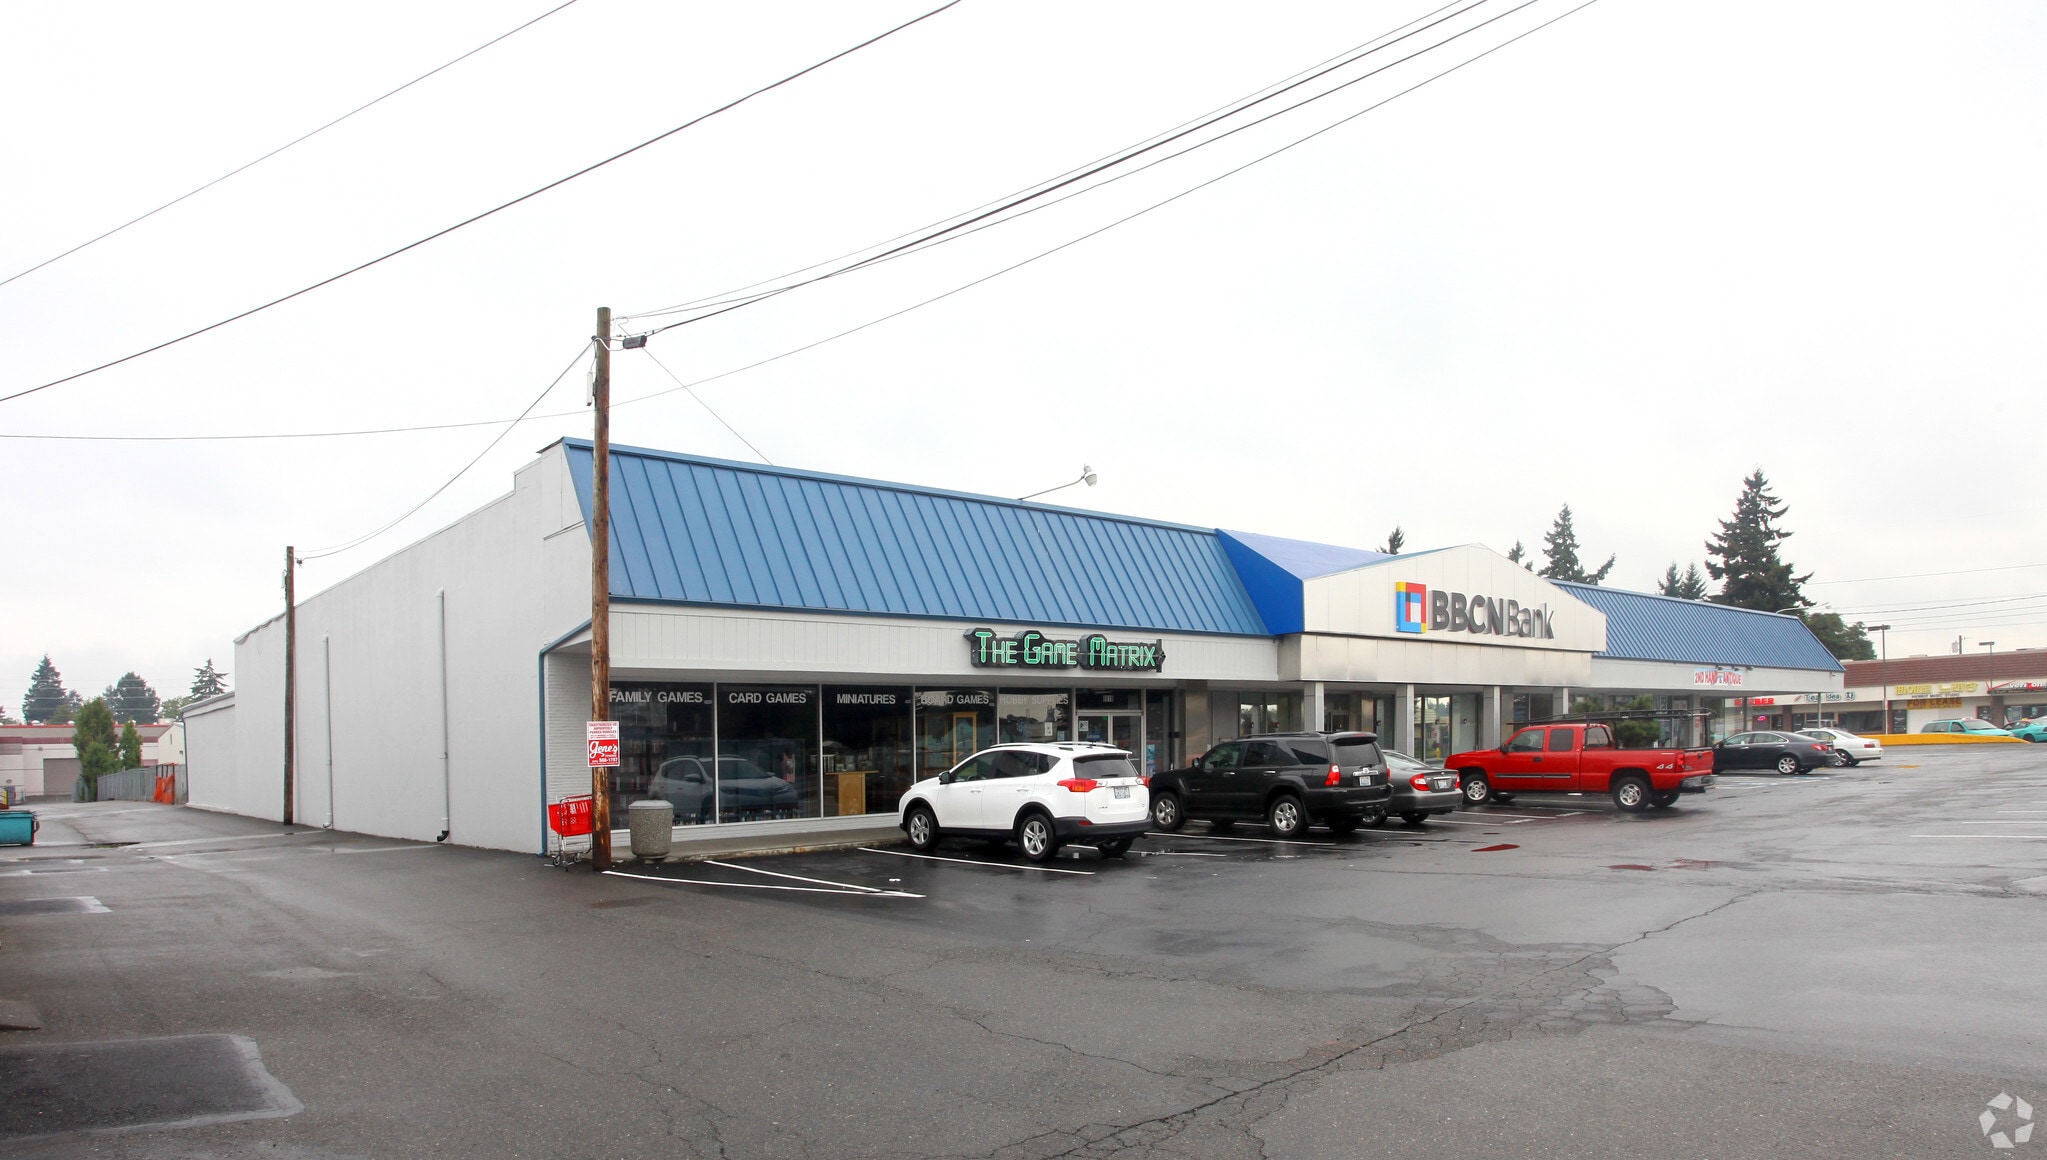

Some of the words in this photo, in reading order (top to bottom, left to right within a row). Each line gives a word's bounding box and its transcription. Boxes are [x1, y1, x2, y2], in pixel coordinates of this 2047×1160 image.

[1428, 590, 1503, 635] BBCN
[1503, 599, 1555, 639] Bank
[609, 691, 652, 703] FAMILY
[657, 691, 703, 703] GAMES
[728, 692, 762, 704] CARD
[765, 692, 807, 704] GAMES
[836, 693, 896, 705] MINIATURES
[920, 694, 954, 705] BOARD
[956, 694, 990, 705] GAMES
[1000, 695, 1028, 705] HOBBY
[1734, 698, 1774, 706] BRBER
